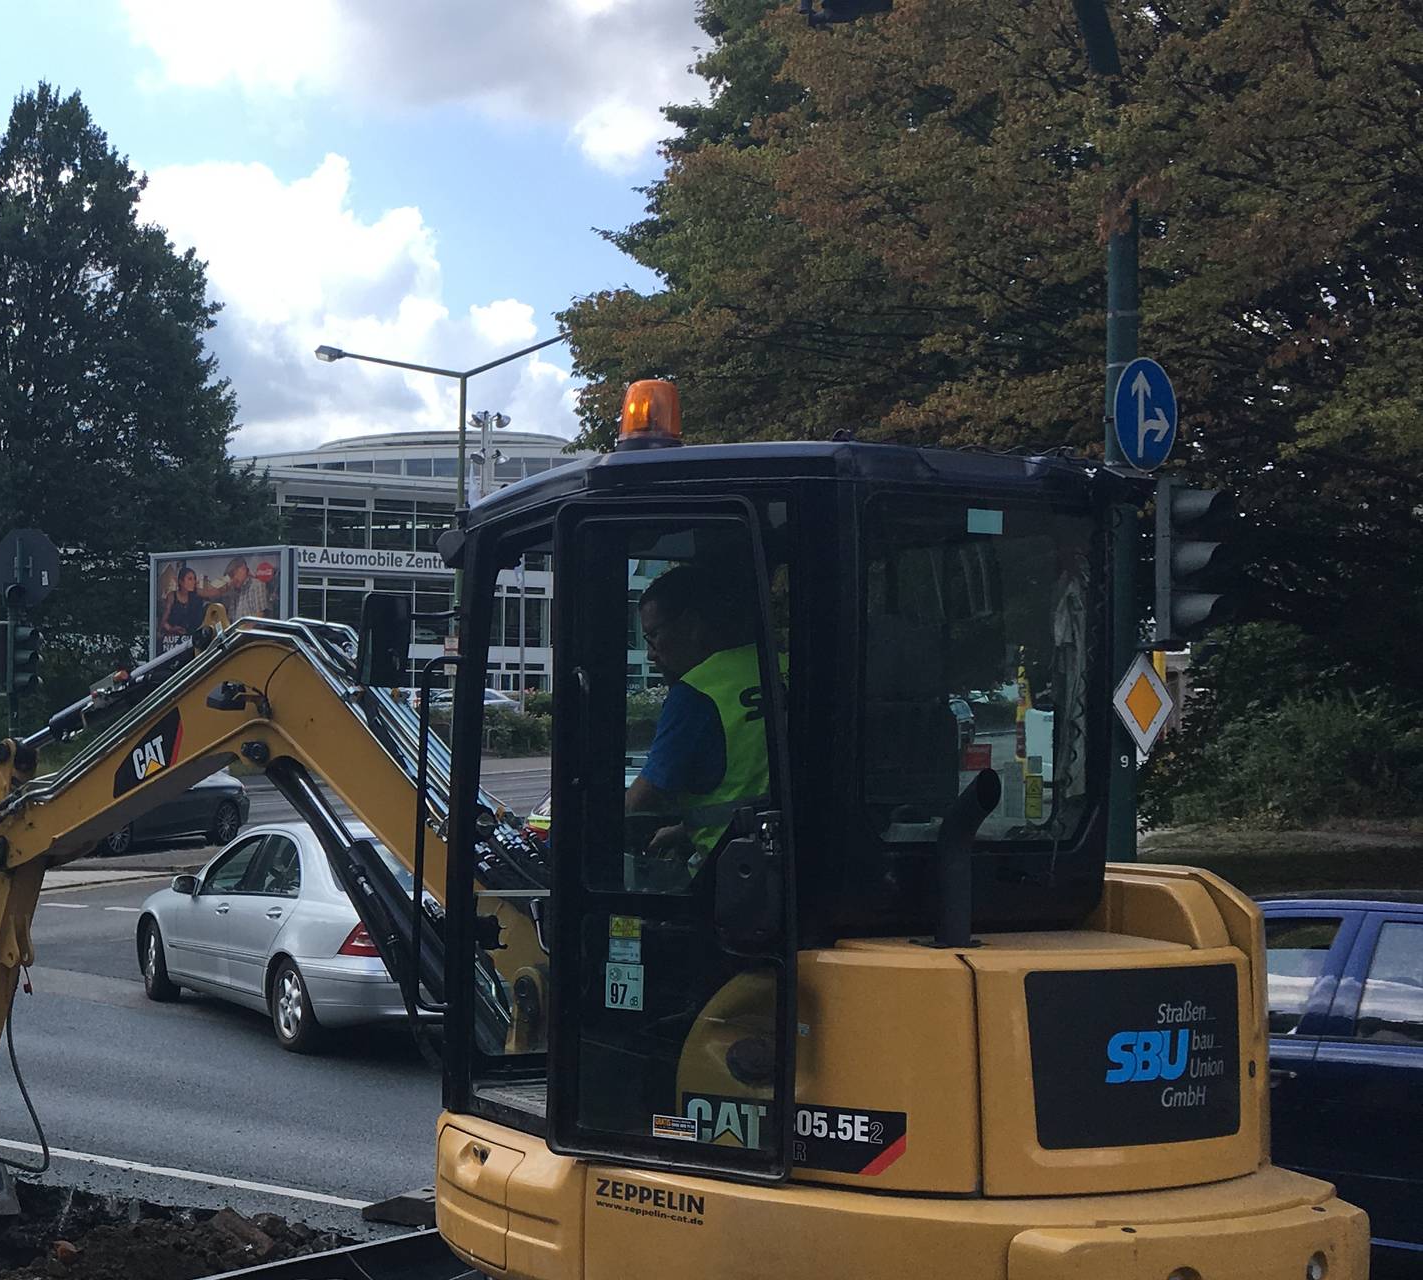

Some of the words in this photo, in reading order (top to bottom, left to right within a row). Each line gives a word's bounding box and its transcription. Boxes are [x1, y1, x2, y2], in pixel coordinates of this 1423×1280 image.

[319, 549, 403, 568] Automobile
[405, 553, 449, 570] Zentr
[162, 635, 180, 644] AUF
[132, 734, 166, 780] CAT
[1119, 755, 1129, 768] 9
[609, 982, 628, 1005] 97
[1105, 1028, 1190, 1084] SBU
[1189, 1057, 1225, 1079] Union
[1161, 1085, 1207, 1108] GmbH
[687, 1098, 768, 1150] CAT
[793, 1109, 884, 1145] 05.5E2
[596, 1177, 705, 1216] ZEPPELIN
